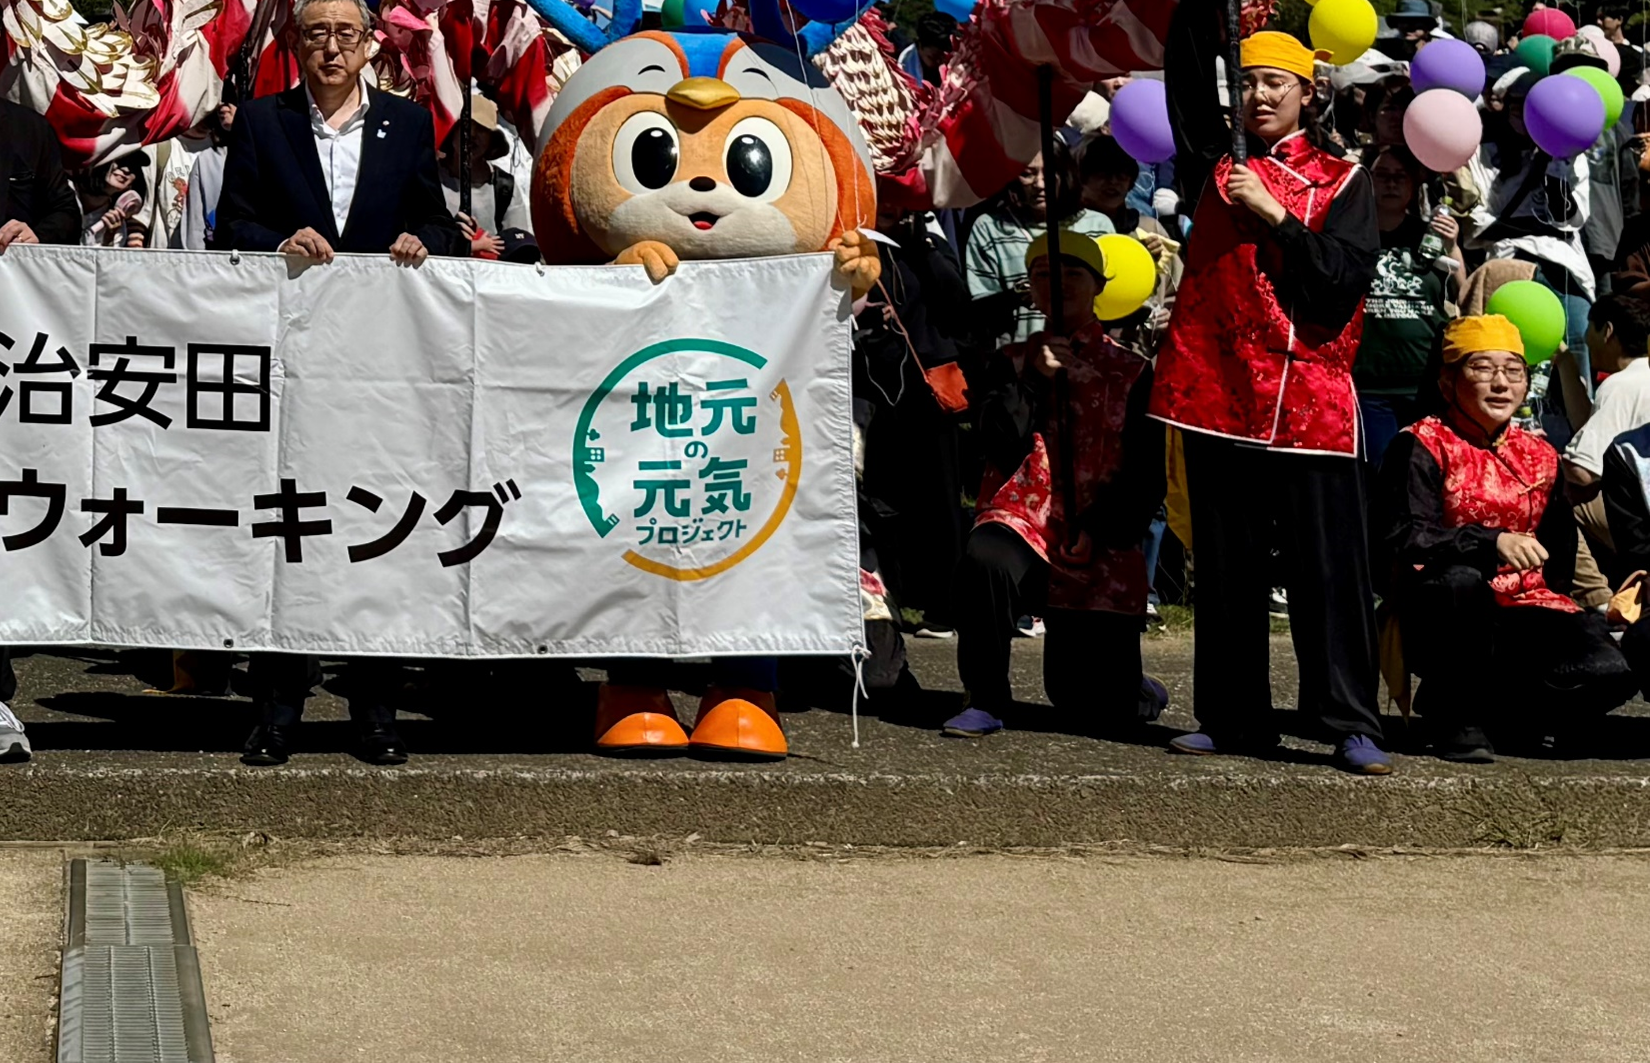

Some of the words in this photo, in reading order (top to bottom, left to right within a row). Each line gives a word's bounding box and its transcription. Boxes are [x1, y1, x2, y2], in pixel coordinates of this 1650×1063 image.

[630, 378, 757, 438] 地元
[684, 440, 709, 460] の
[633, 457, 752, 518] 元気
[636, 517, 747, 545] プロジェクト
